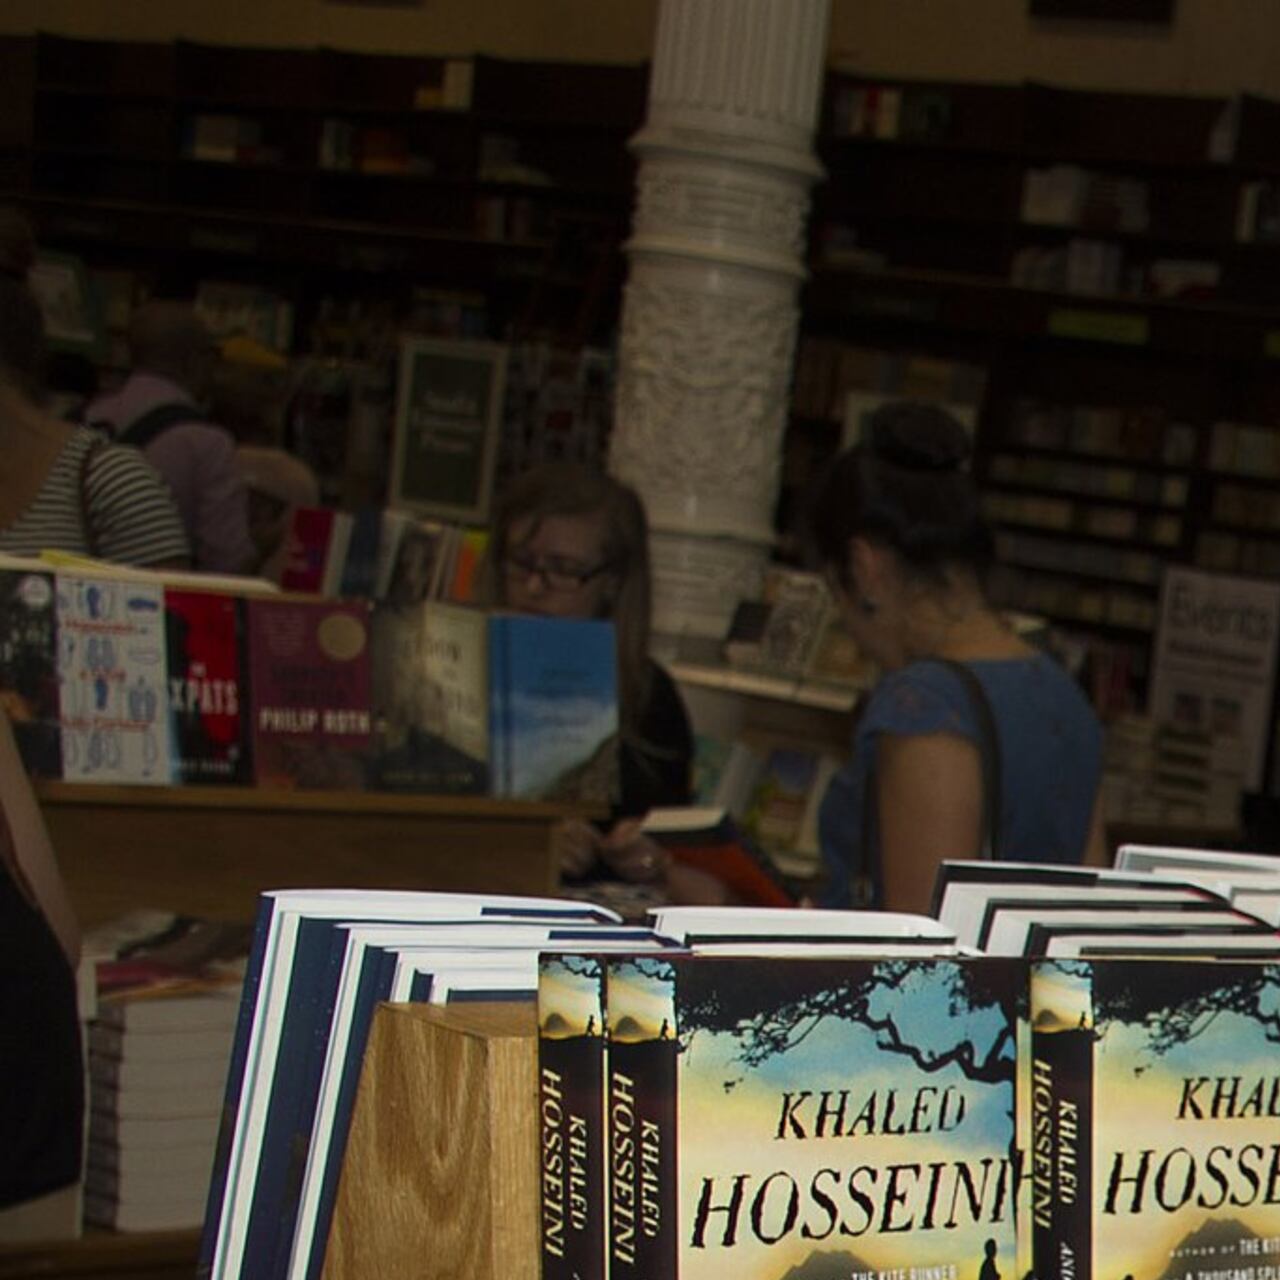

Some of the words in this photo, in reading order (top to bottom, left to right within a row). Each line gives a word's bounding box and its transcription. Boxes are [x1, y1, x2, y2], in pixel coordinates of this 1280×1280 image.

[169, 676, 239, 716] XPATS
[259, 709, 320, 736] PHILIP
[324, 712, 371, 737] ROTH
[541, 1067, 565, 1259] HOSSEINI
[612, 1071, 636, 1266] HOSSEINI
[773, 1084, 967, 1141] KHALED
[1032, 1058, 1053, 1230] HOSSEINI
[1057, 1099, 1078, 1204] KHALED
[568, 1113, 588, 1232] KHALED
[640, 1118, 661, 1239] KHALED
[689, 1157, 1013, 1250] HOSSEINI
